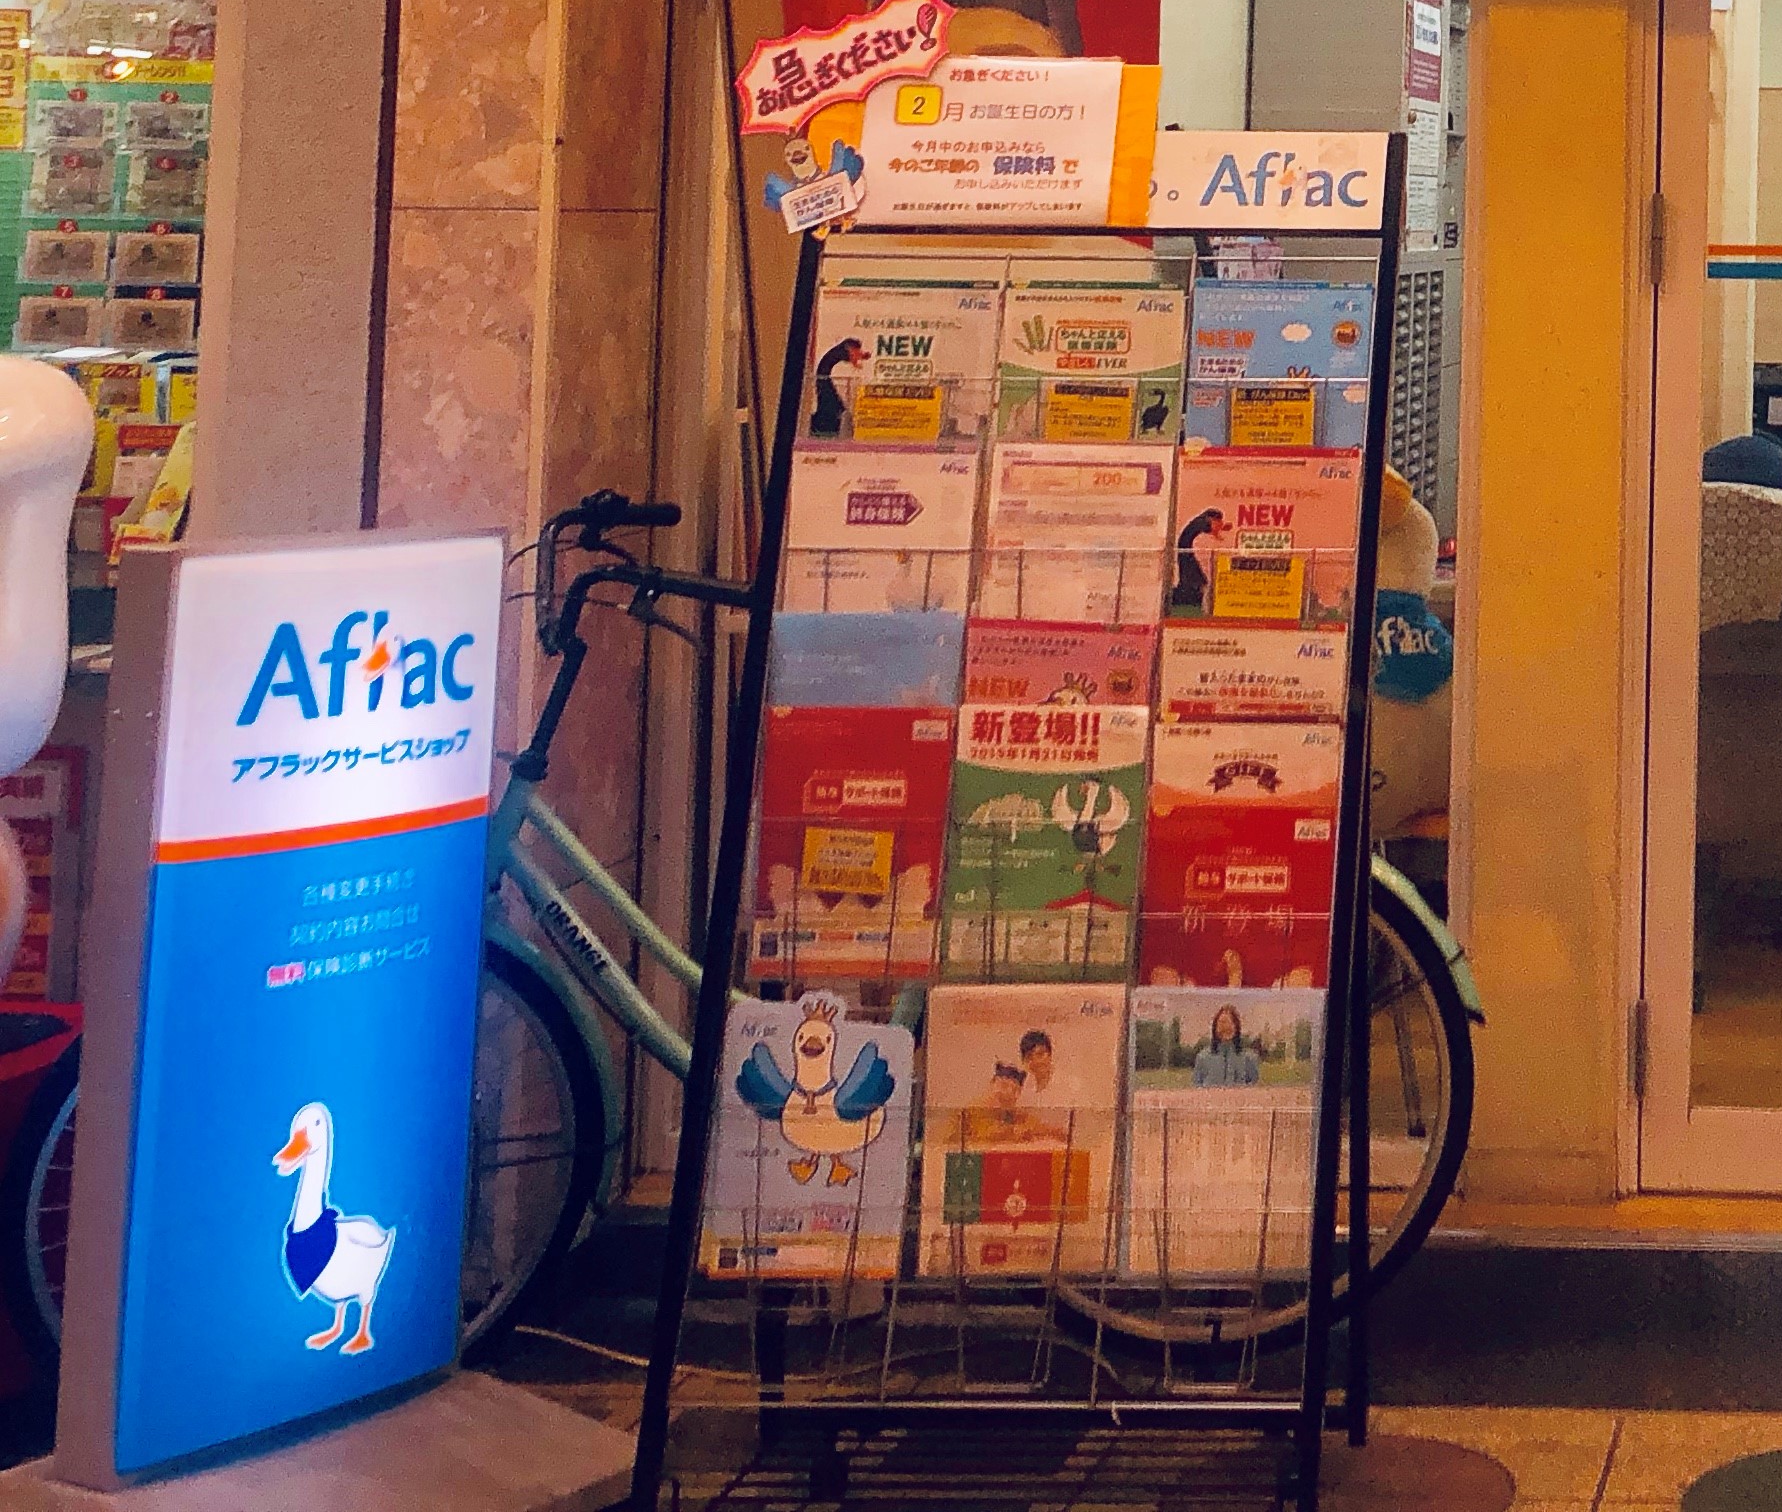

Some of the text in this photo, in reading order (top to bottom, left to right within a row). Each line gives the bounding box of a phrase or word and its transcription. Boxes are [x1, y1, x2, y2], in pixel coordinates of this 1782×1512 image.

[911, 95, 927, 116] 2
[1199, 151, 1368, 208] Aflac
[876, 334, 935, 357] NEW
[1237, 504, 1295, 527] NEW
[237, 609, 476, 727] Aflac
[231, 728, 472, 784] アフラックサービスショップ
